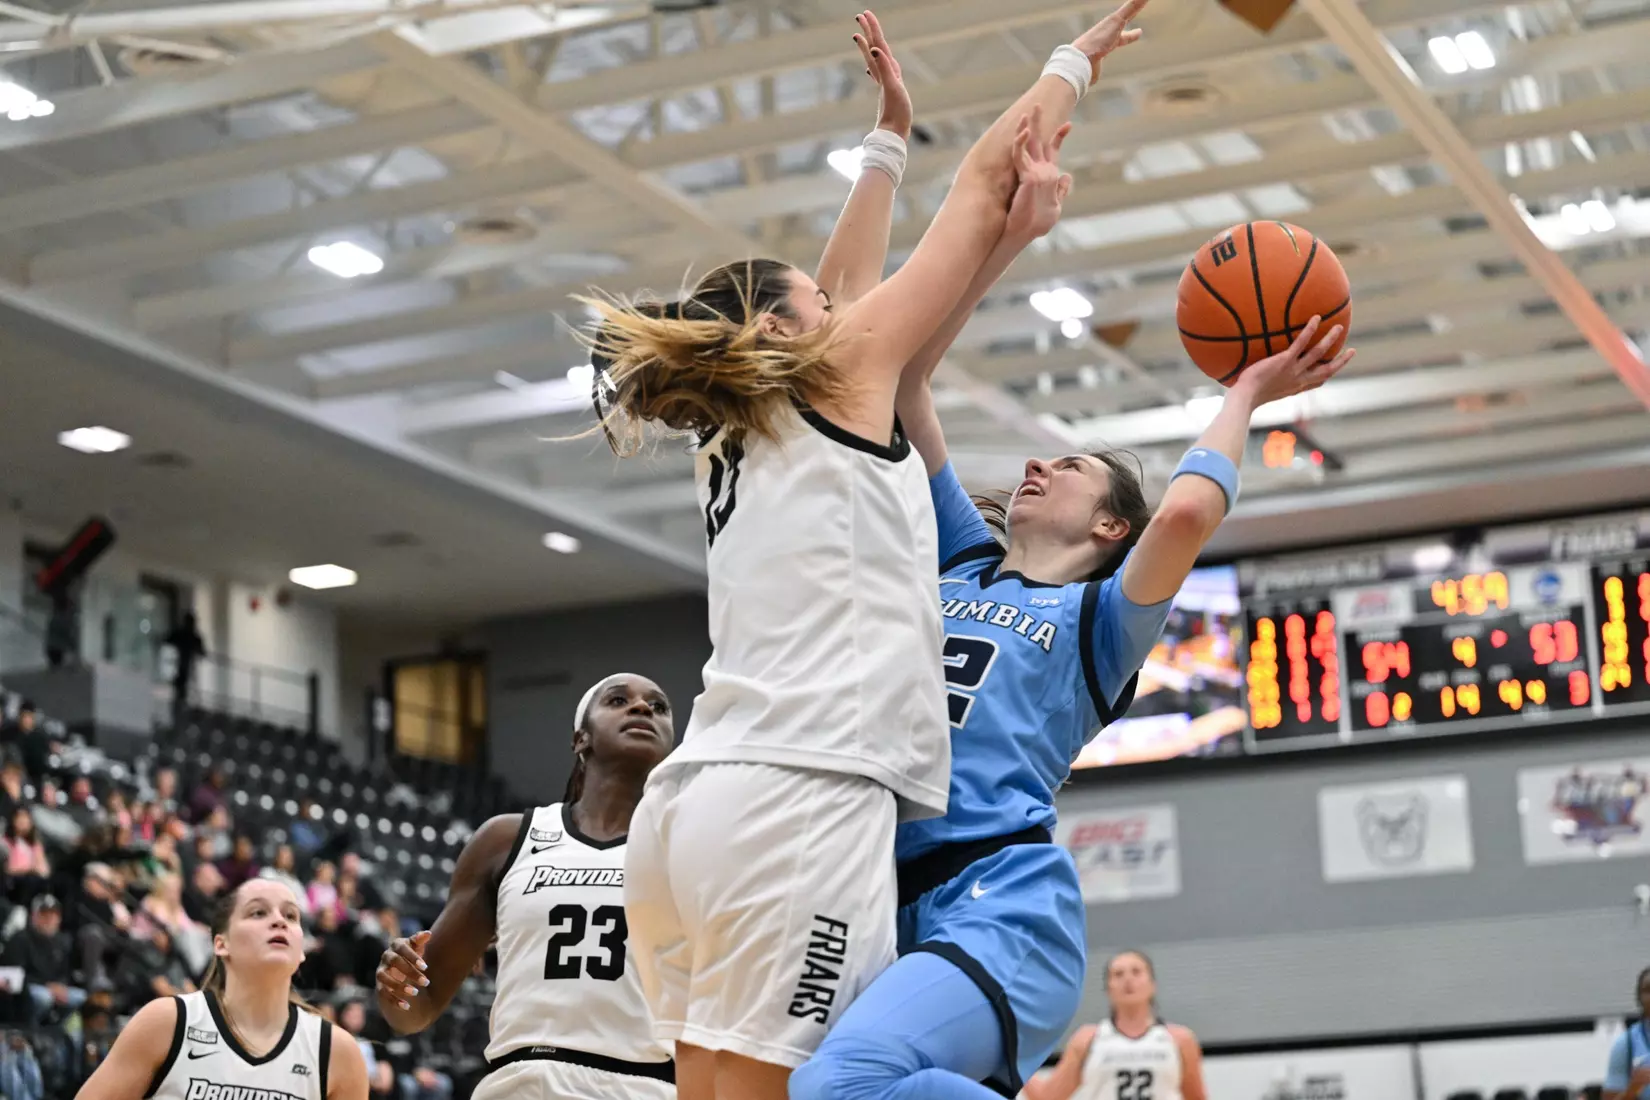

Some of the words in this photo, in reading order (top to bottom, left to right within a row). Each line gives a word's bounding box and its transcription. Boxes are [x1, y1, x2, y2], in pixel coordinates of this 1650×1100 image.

[940, 598, 1058, 654] UMBIA
[544, 904, 628, 981] 23
[787, 914, 848, 1024] FRIARS
[1116, 1070, 1154, 1100] 22
